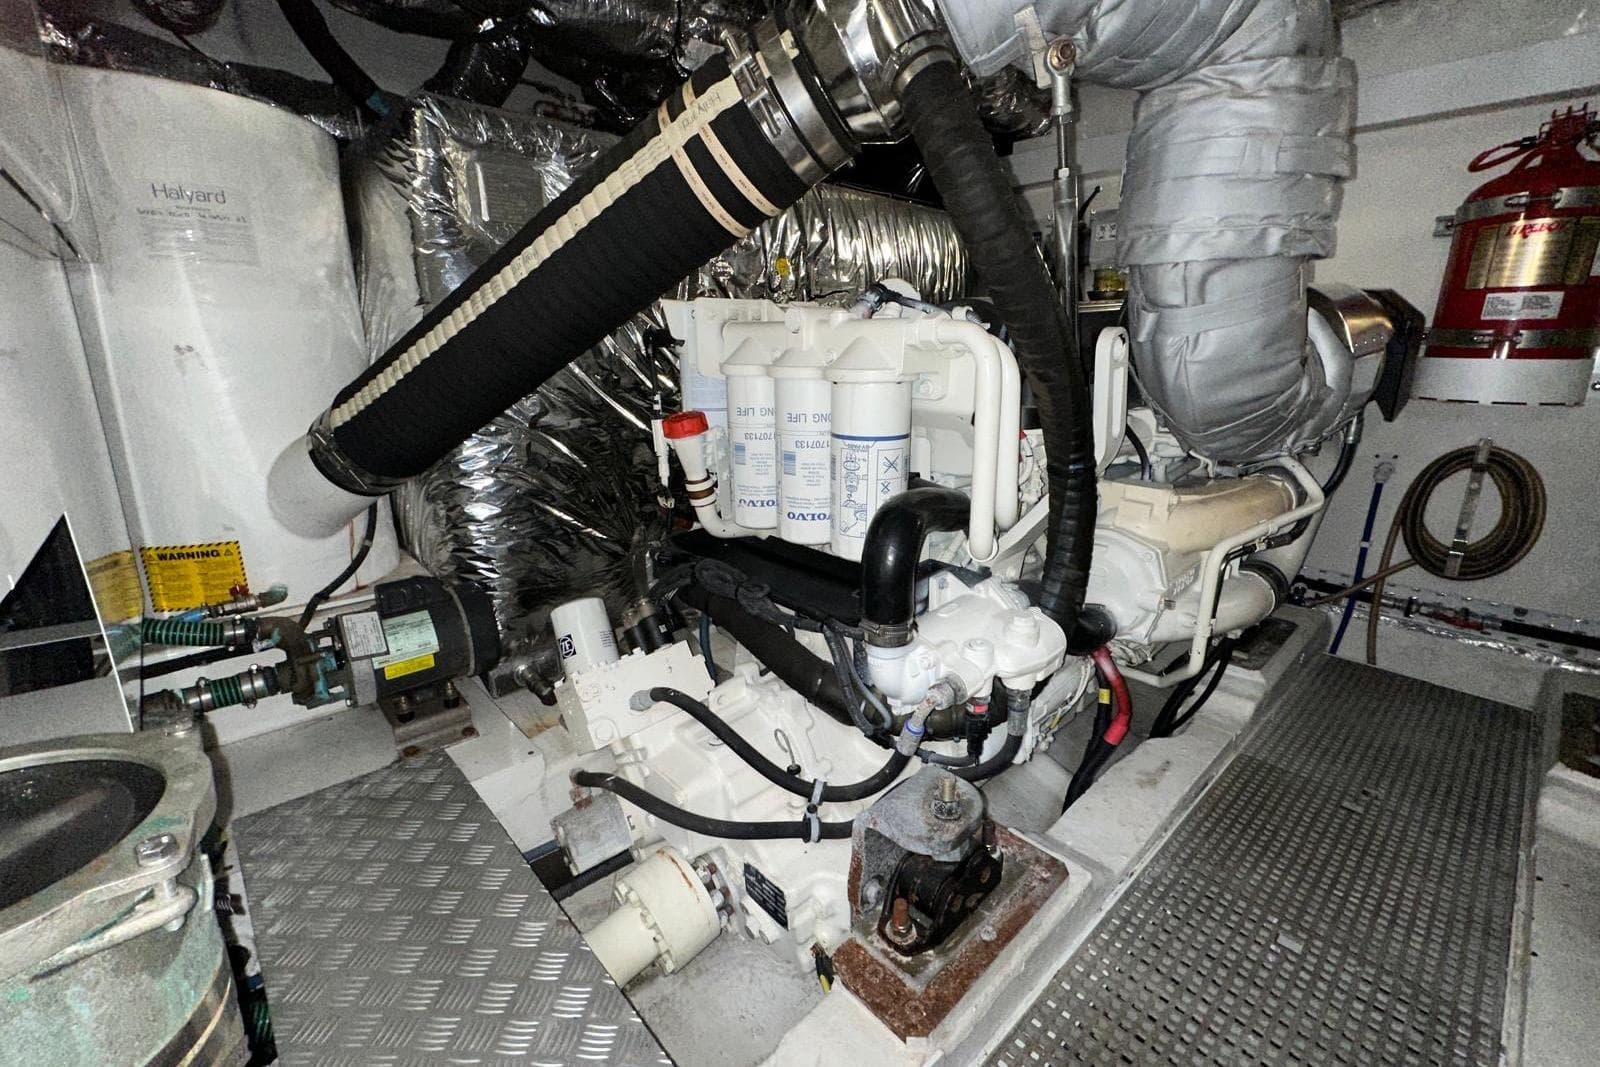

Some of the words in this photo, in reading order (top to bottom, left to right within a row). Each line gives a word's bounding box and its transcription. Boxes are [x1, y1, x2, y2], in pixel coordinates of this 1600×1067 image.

[151, 182, 227, 204] Halyard
[736, 407, 755, 416] LIFE
[760, 407, 775, 417] NG
[787, 412, 807, 424] LIFE
[812, 412, 832, 423] ONG
[795, 440, 830, 449] 1707133
[739, 498, 778, 508] OLVO
[157, 549, 221, 561] WARNING
